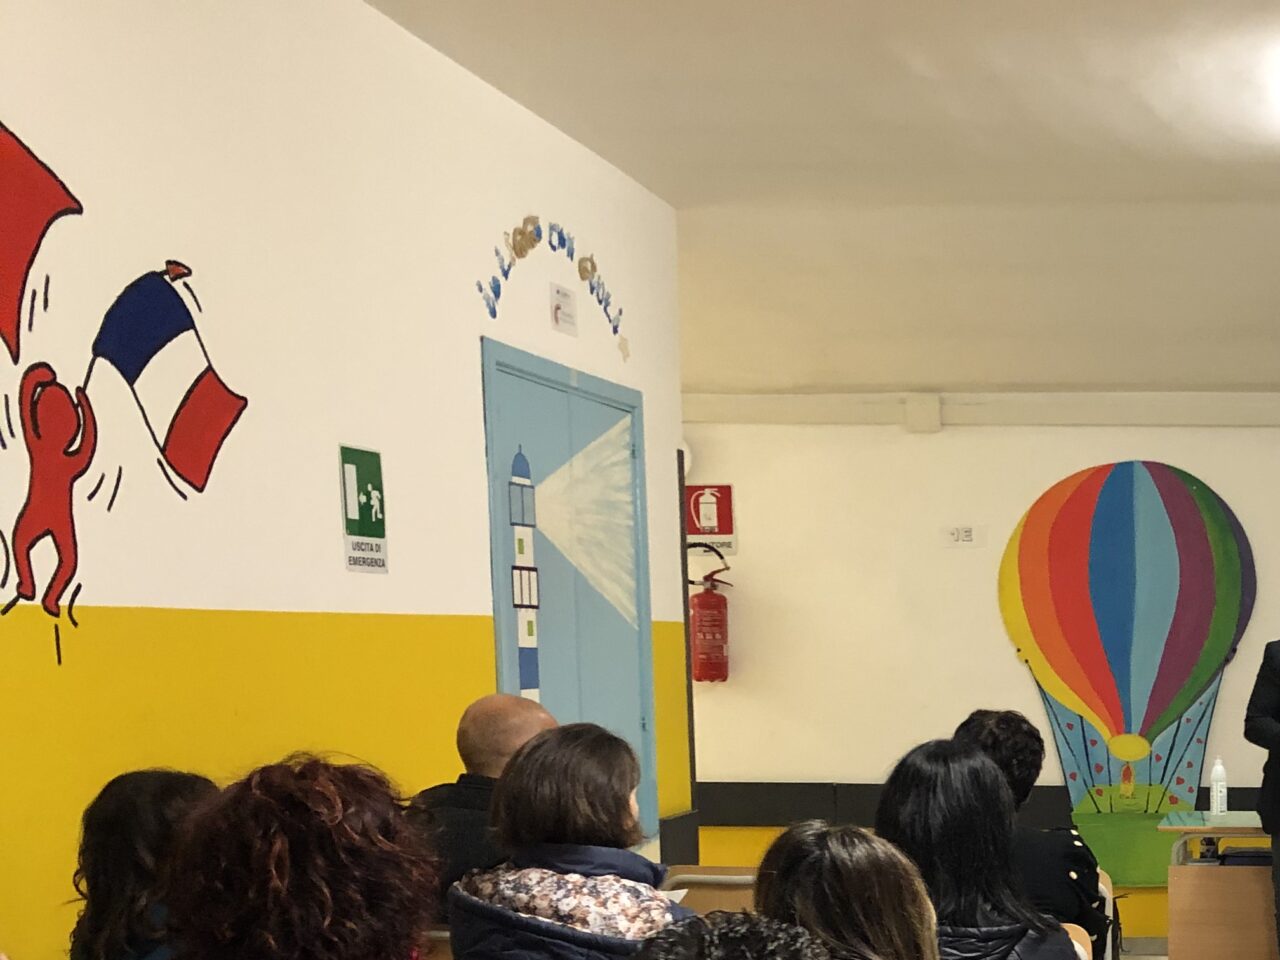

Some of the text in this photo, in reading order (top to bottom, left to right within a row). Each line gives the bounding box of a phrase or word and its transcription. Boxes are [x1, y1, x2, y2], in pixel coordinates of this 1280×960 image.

[351, 540, 382, 553] USCITA DI
[348, 555, 386, 568] EMERGENZA
